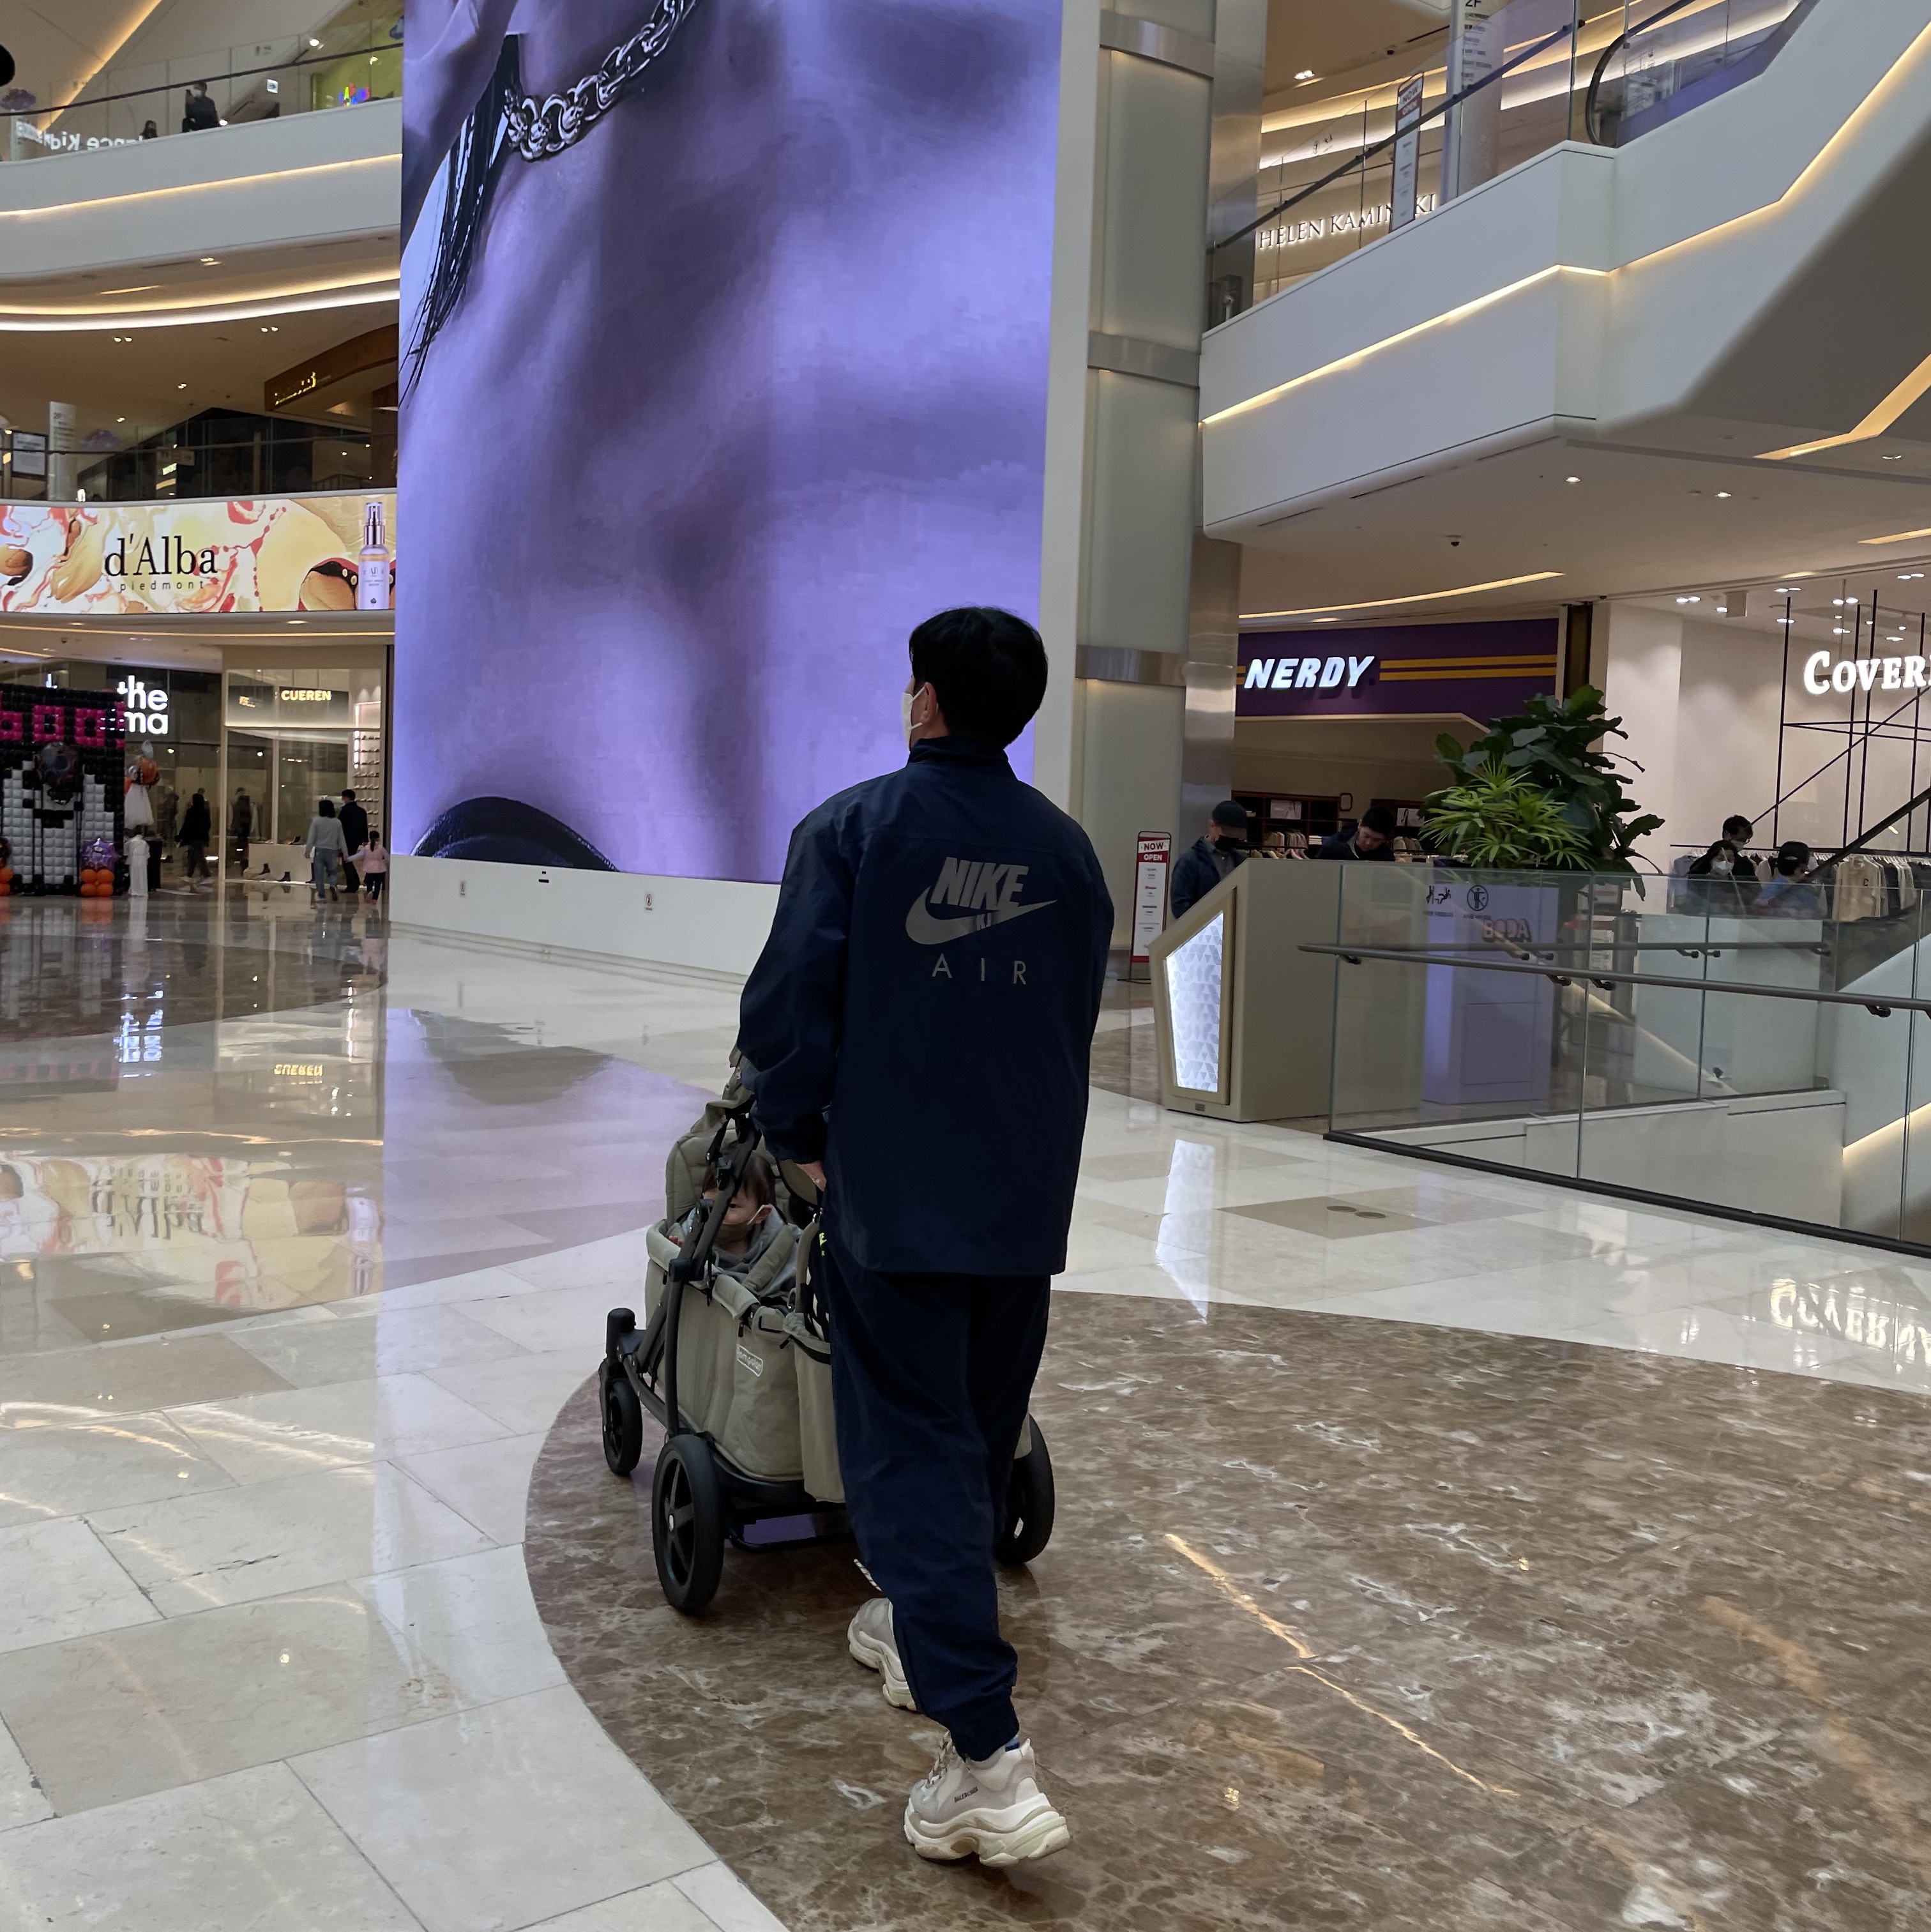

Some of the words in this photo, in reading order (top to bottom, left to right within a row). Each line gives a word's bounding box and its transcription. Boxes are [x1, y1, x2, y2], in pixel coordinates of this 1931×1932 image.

[1259, 218, 1324, 248] HELEN
[104, 533, 218, 576] d'Alba
[120, 580, 204, 593] piedmont
[1245, 656, 1375, 689] NERDY
[1804, 650, 1931, 694] COVER
[281, 690, 331, 701] CUEREN
[1144, 842, 1164, 851] NOW
[930, 856, 1029, 911] NIKE
[932, 952, 1027, 985] AIR
